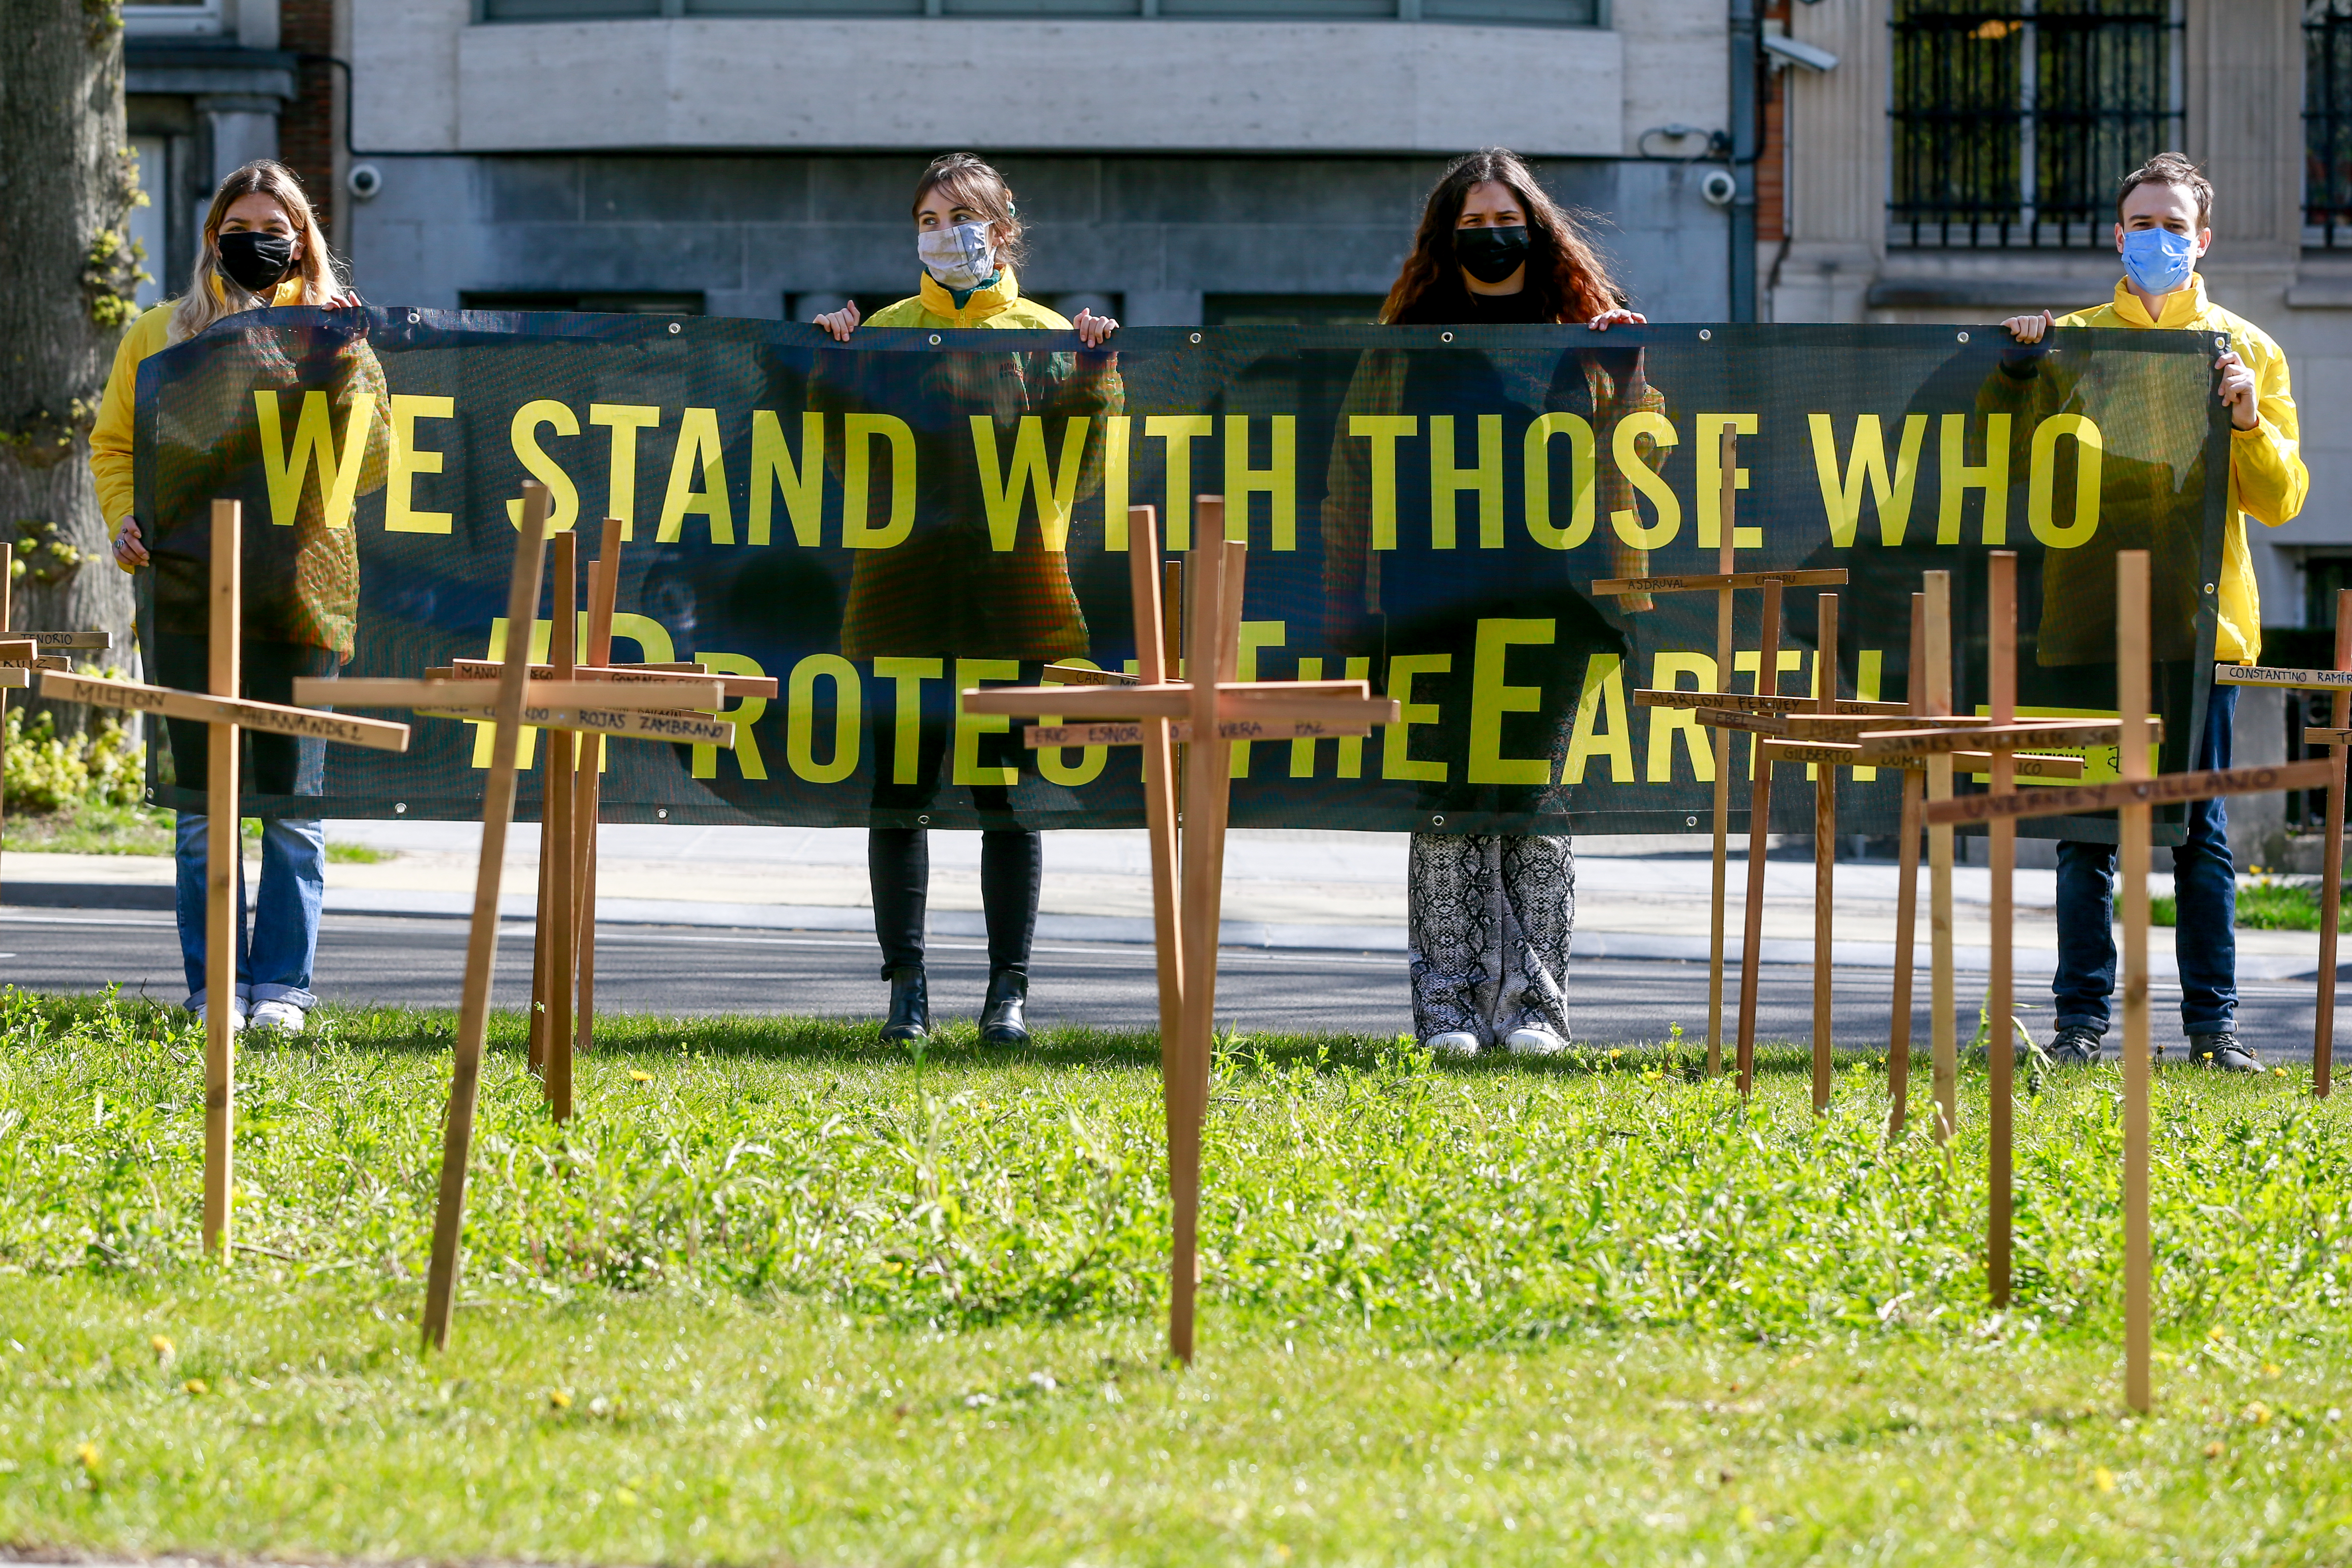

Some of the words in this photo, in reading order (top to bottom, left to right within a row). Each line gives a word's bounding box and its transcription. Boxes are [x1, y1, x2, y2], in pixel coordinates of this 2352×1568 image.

[254, 390, 454, 534] WE
[506, 399, 917, 549] STAND
[969, 415, 1296, 551] WITH
[1349, 411, 1763, 551] THOSE
[1808, 413, 2103, 549] WHO
[1628, 579, 1688, 591] ASDRUVAL
[2229, 668, 2307, 682] CONSTANTINO
[73, 682, 166, 708] MILTON
[1650, 693, 1724, 707] MARLON
[1737, 696, 1801, 714] FERNEY
[579, 710, 626, 729] ROJAS
[640, 716, 724, 738] ZAMBRANO
[1715, 712, 1747, 727] EBEL
[1783, 746, 1853, 763] GILBERTO
